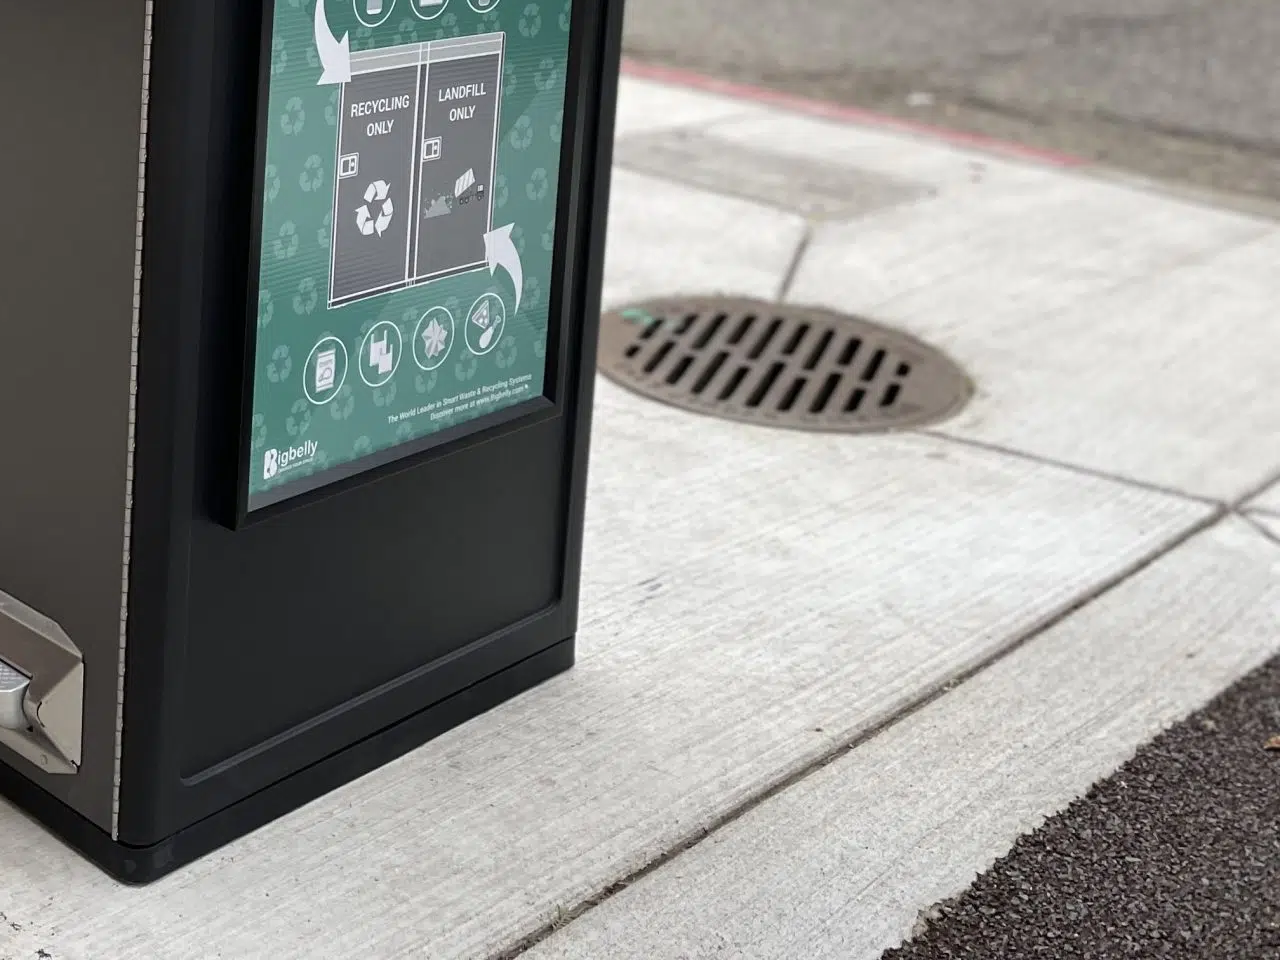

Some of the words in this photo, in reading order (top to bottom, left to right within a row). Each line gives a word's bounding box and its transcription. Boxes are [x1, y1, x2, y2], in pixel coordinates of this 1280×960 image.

[438, 82, 487, 102] LANDFILL
[350, 94, 410, 118] RECYCLING
[449, 105, 476, 122] ONLY
[366, 119, 395, 137] ONLY
[388, 415, 399, 424] The
[399, 409, 416, 420] World
[416, 403, 436, 415] Leader
[263, 439, 318, 480] Bigbelly
